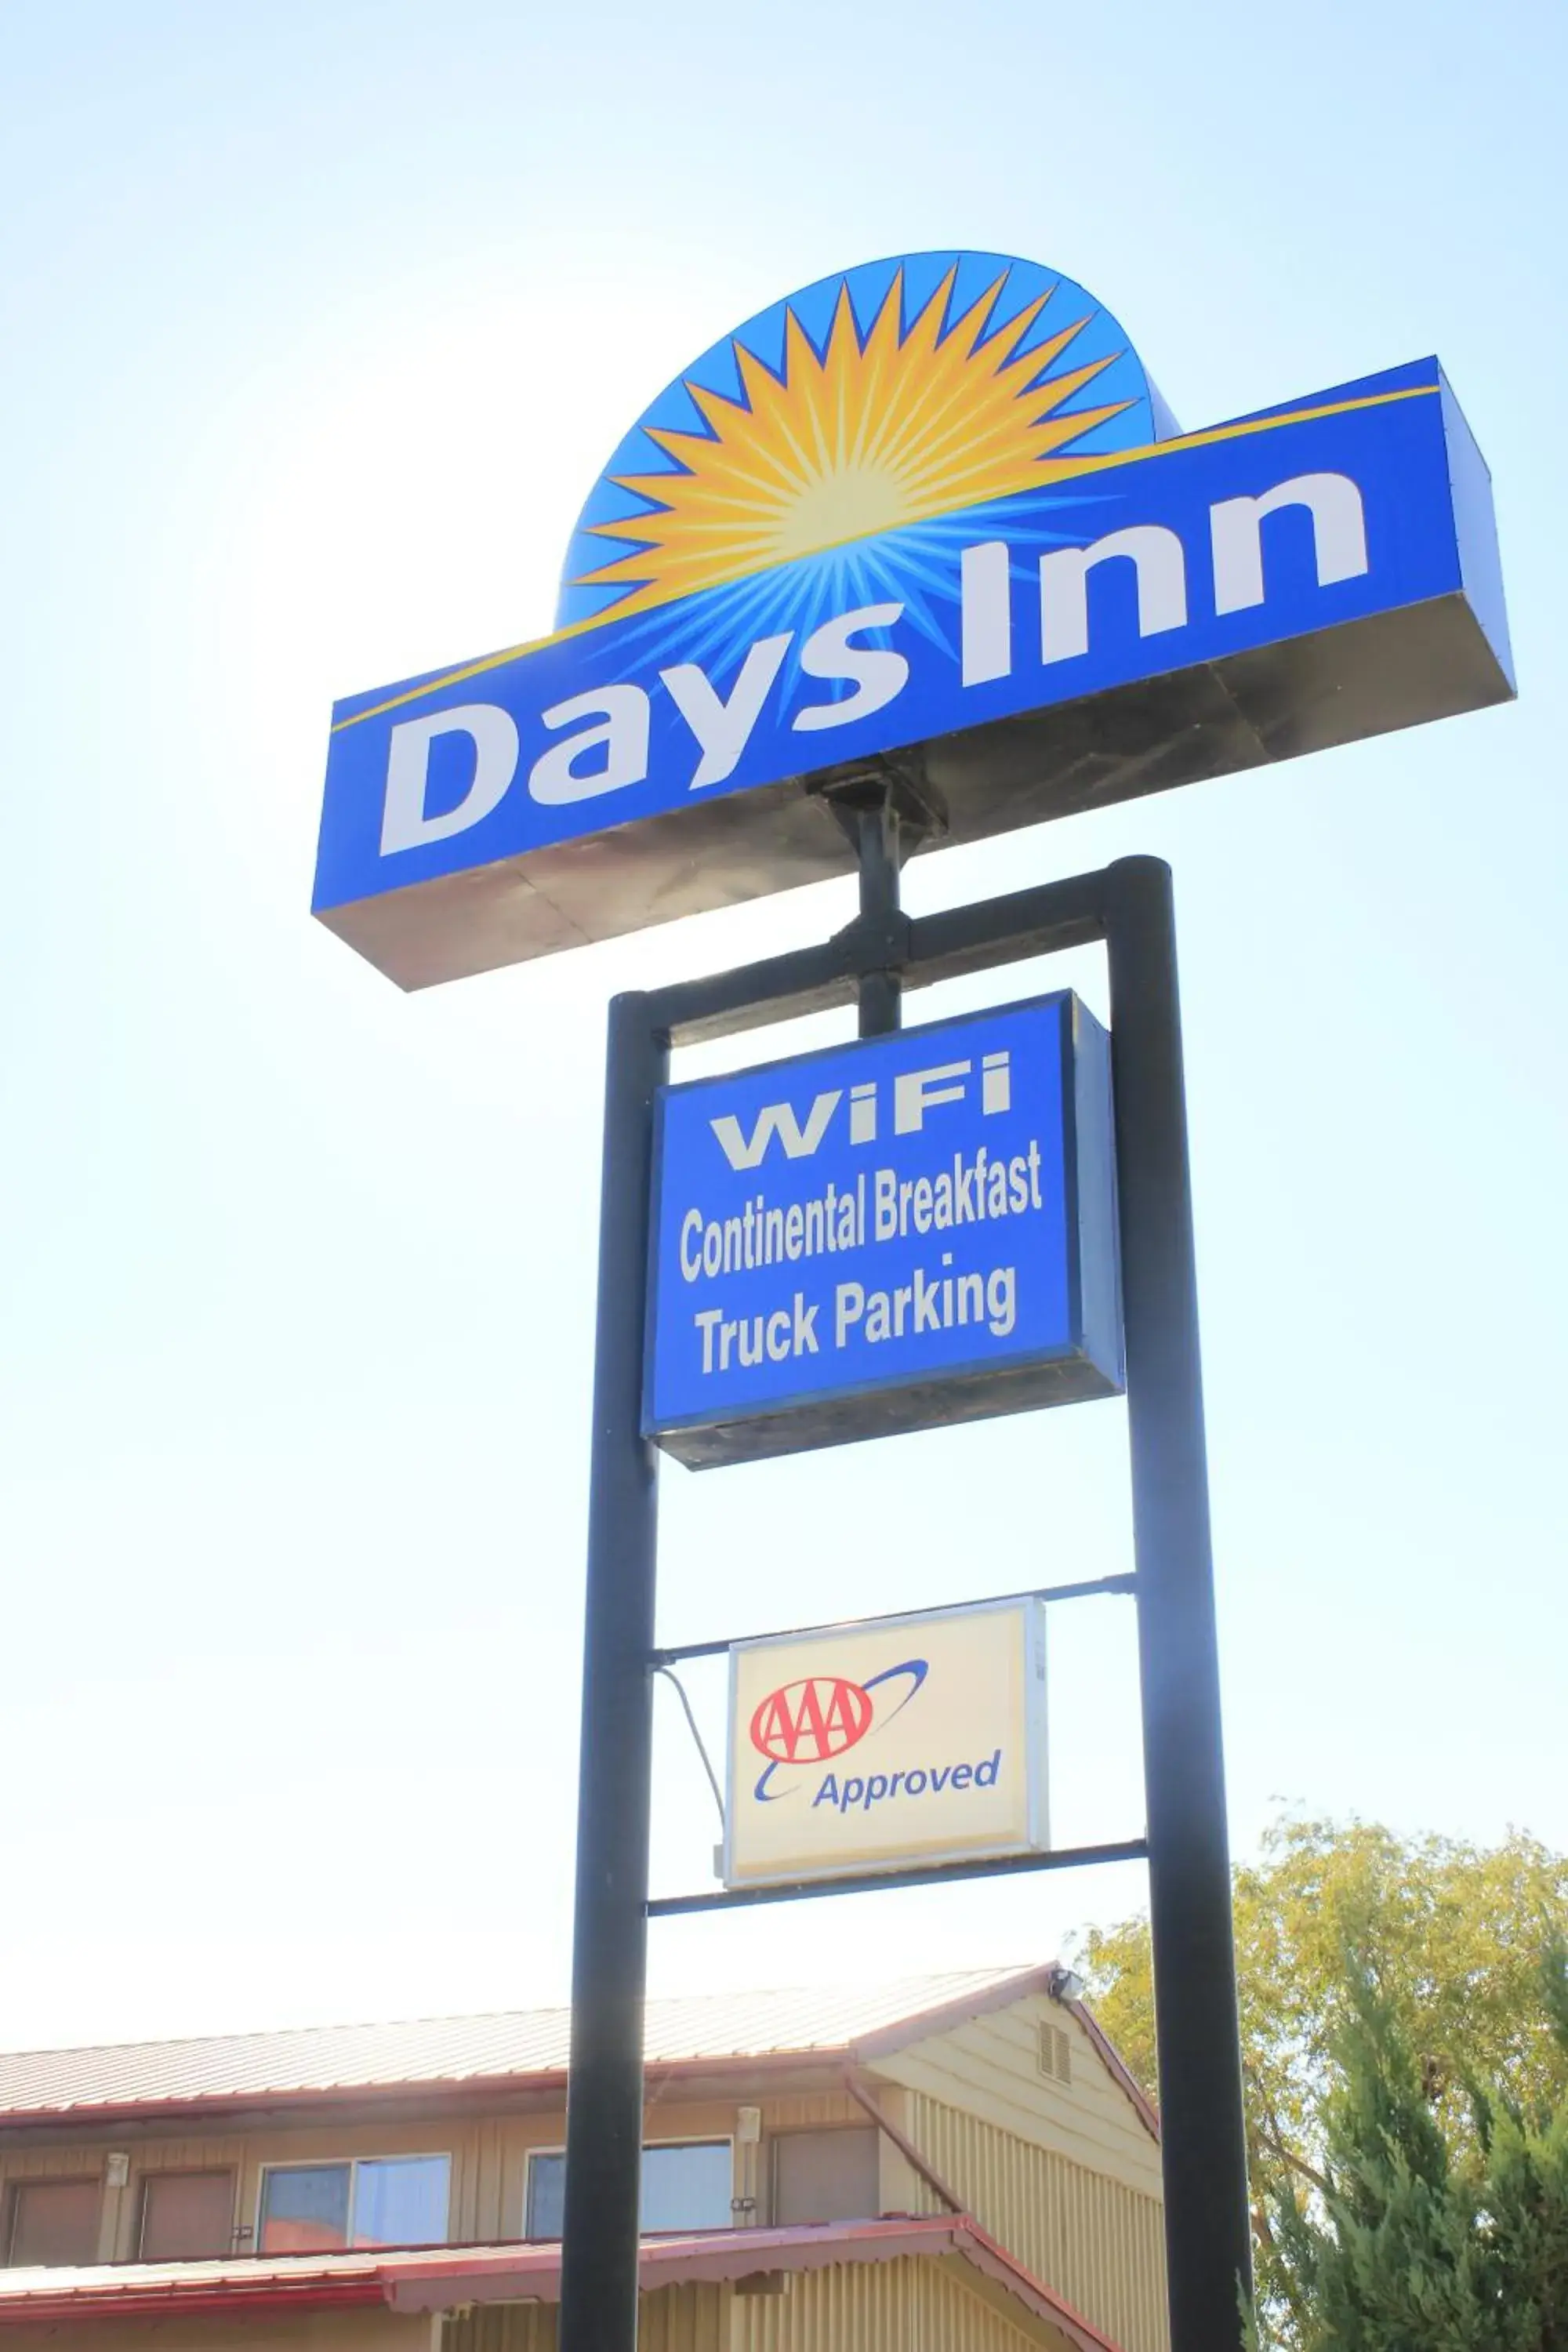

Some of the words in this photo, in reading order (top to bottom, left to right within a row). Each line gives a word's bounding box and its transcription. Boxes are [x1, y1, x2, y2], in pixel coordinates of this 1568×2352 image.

[379, 602, 909, 858] Days
[960, 472, 1368, 688] Inn
[710, 1051, 1011, 1171] WiFi
[680, 1174, 865, 1283] Continental
[875, 1139, 1042, 1242] Breakfast
[694, 1292, 820, 1374] Truck
[836, 1253, 1015, 1348] Parking
[764, 1679, 857, 1759] AAA
[811, 1749, 1001, 1813] Approved
